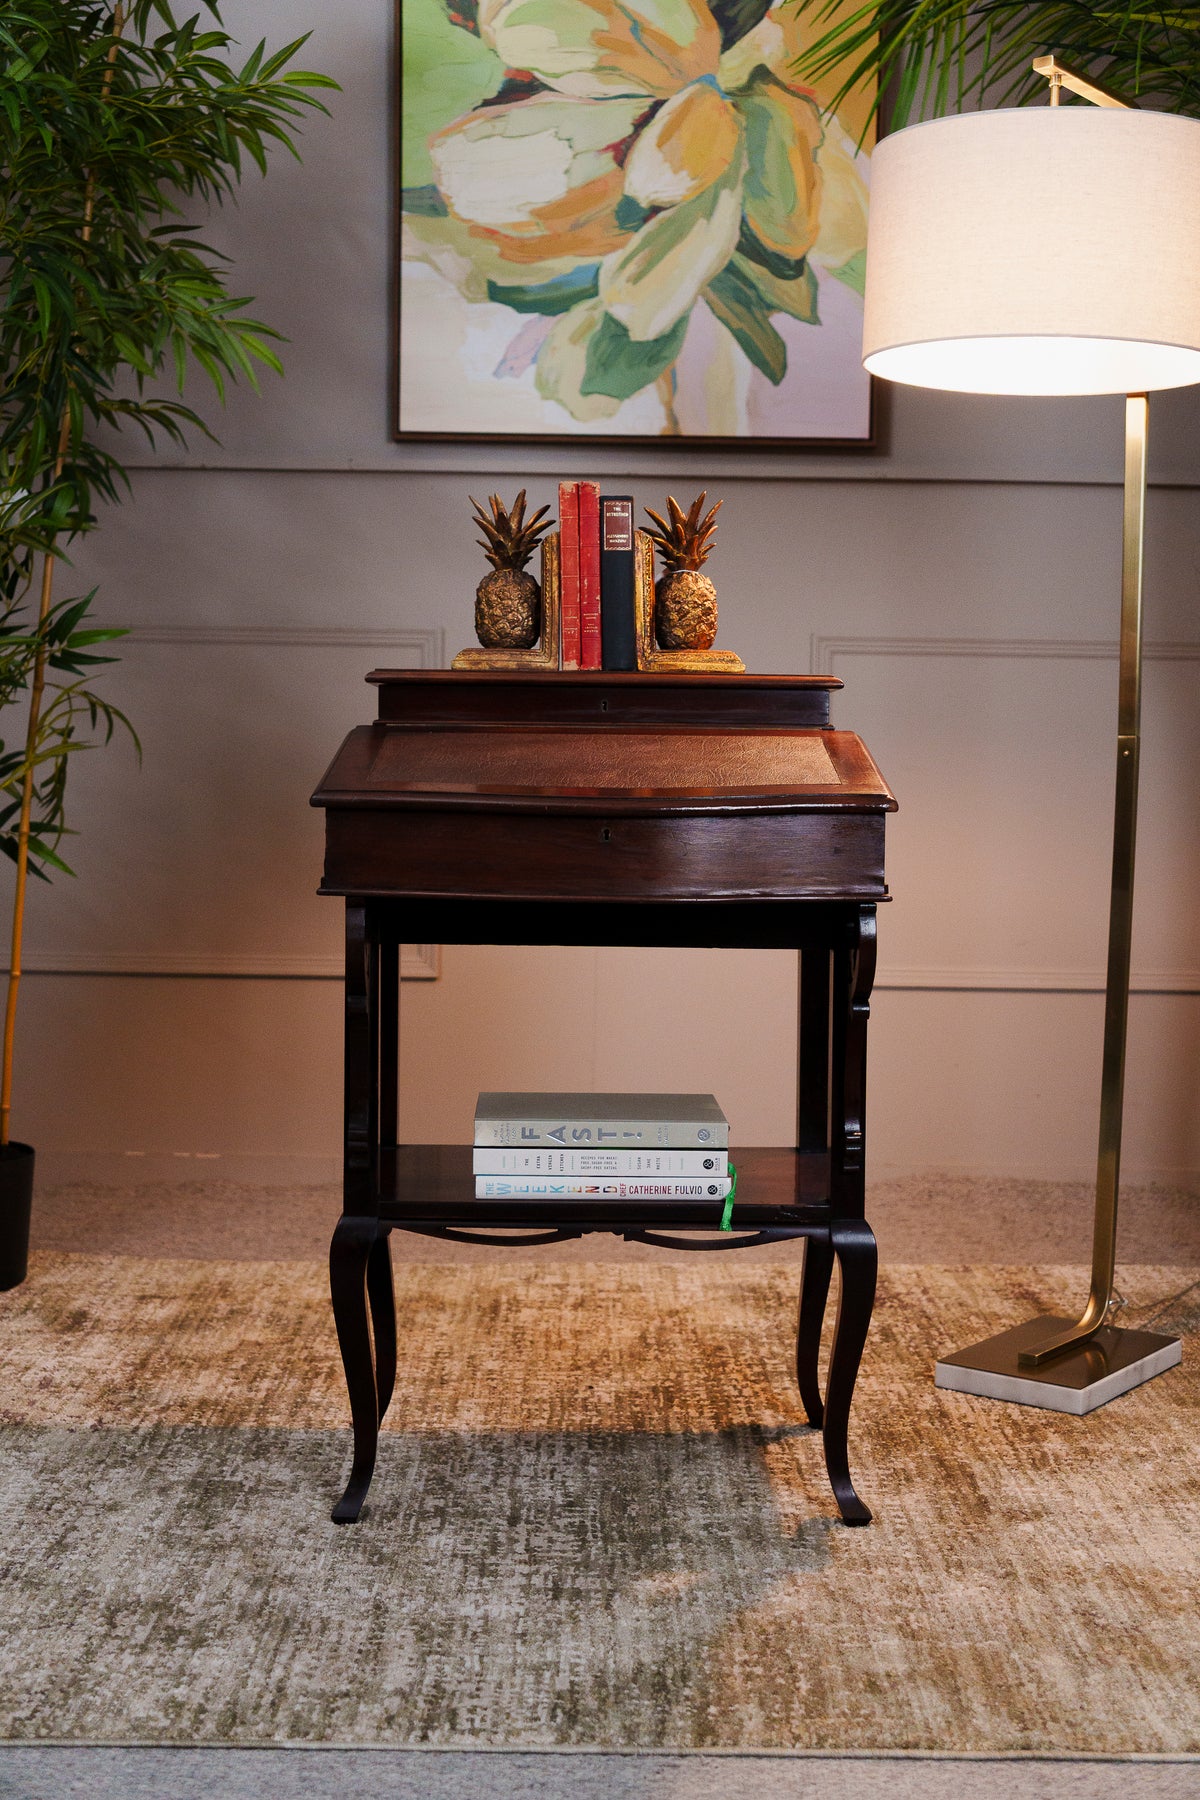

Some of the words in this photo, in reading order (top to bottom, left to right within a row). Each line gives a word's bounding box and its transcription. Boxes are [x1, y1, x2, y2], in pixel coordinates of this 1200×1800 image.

[485, 1182, 495, 1196] THE
[619, 1182, 627, 1197] CHEF
[629, 1184, 672, 1196] CATHERINE
[674, 1184, 703, 1196] FULVIO
